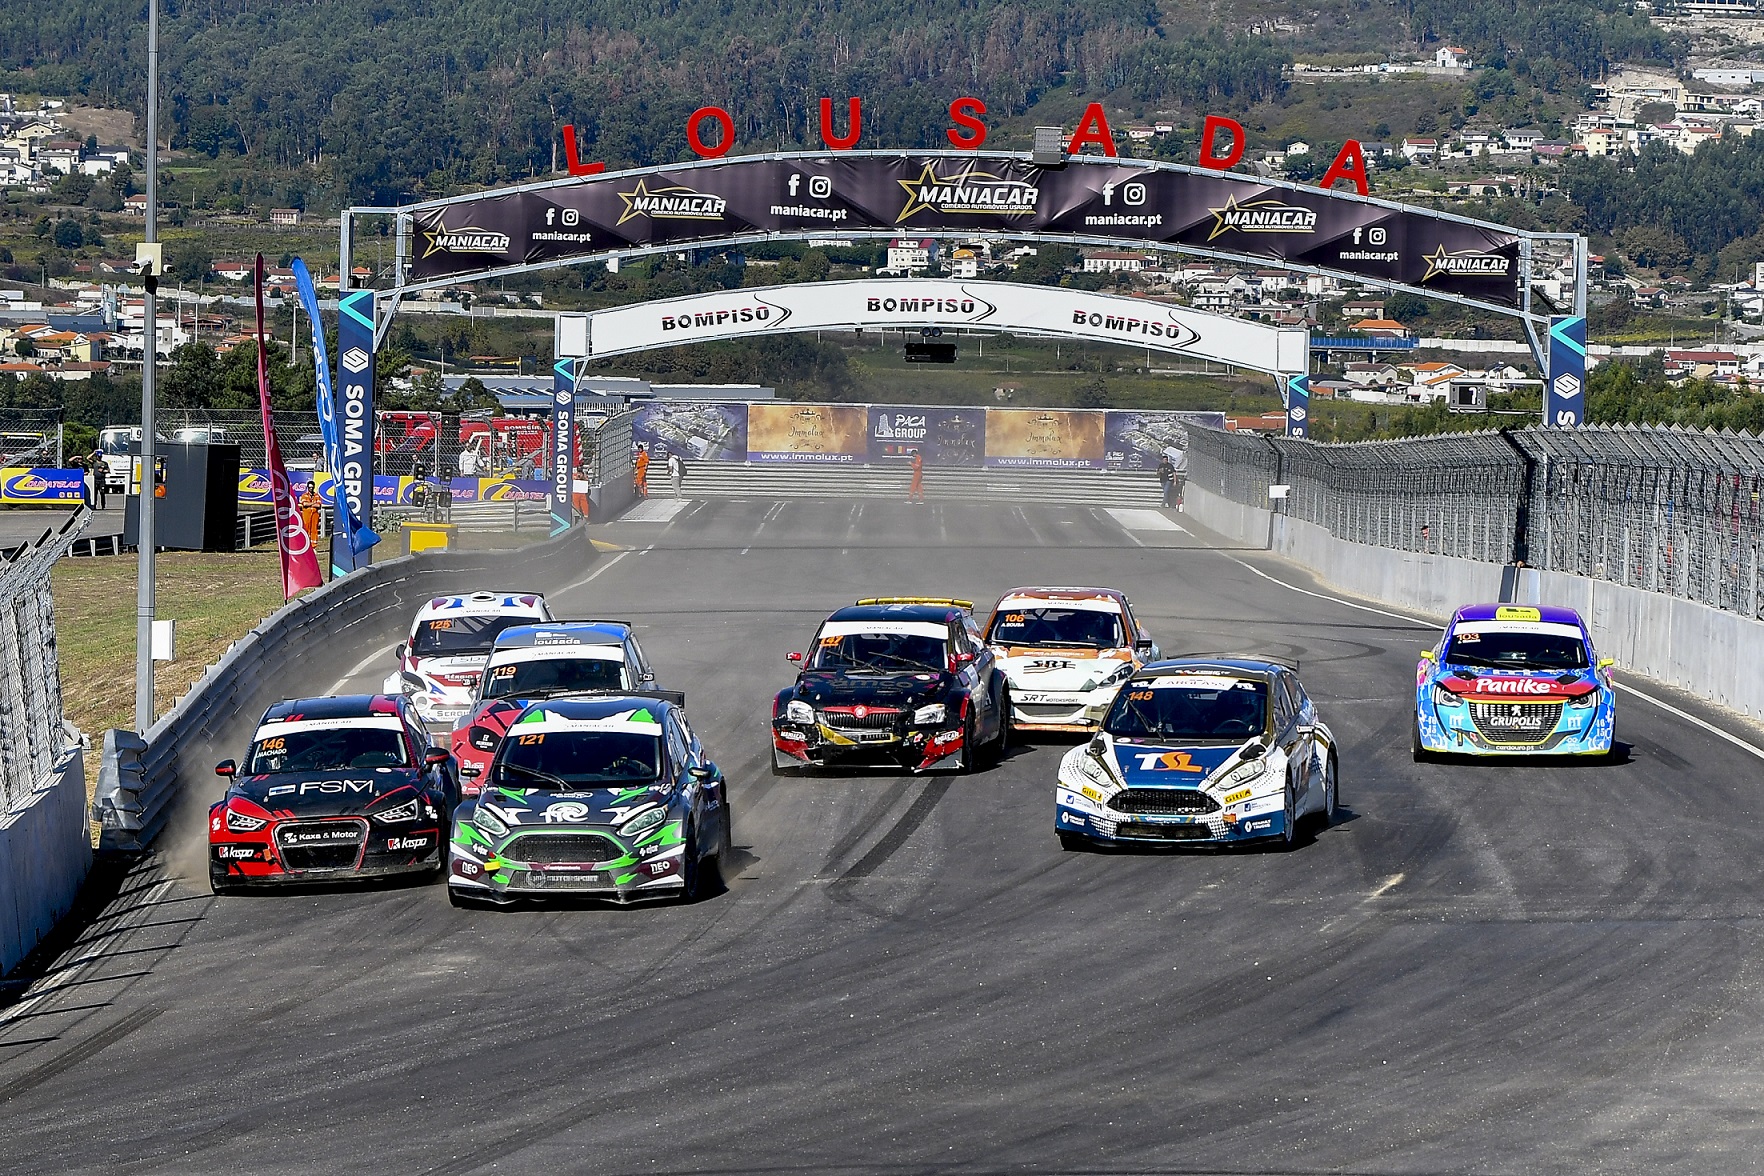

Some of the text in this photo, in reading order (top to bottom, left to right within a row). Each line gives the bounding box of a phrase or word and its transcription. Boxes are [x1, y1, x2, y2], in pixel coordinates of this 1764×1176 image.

[918, 185, 1039, 205] MANIACAR
[634, 196, 727, 213] MANIACAR
[770, 204, 848, 222] maniacar.pt
[1223, 211, 1317, 226] MANIACAR
[1084, 213, 1162, 228] maniacar.pt
[435, 235, 511, 248] MANIACAR
[532, 230, 591, 244] maniacar.pt
[1339, 249, 1399, 263] maniacar.pt
[1433, 257, 1510, 271] MANIACAR
[867, 297, 975, 314] BOMPISO
[661, 305, 770, 331] BOMPISO
[1072, 309, 1180, 339] BOMPISO
[344, 384, 365, 458] SOMA
[895, 413, 926, 428] PACA
[894, 428, 927, 439] GROUP
[556, 411, 569, 504] SOMA GROUP
[760, 452, 853, 463] www.immolux.pt
[998, 457, 1091, 468] www.immolux.pt
[429, 619, 452, 630] 125
[1005, 614, 1025, 623] 106
[534, 638, 581, 646] lousada
[493, 666, 517, 677] 119
[1475, 678, 1552, 694] Panike
[1020, 694, 1048, 702] SRT
[1128, 690, 1154, 701] 148
[1490, 716, 1542, 726] GRUPOLIS
[261, 737, 286, 751] 146
[518, 733, 546, 746] 121
[1134, 751, 1203, 772] TSL
[299, 779, 374, 796] FSM
[1225, 793, 1243, 803] Giti
[299, 830, 358, 841] Kaxa & Motor
